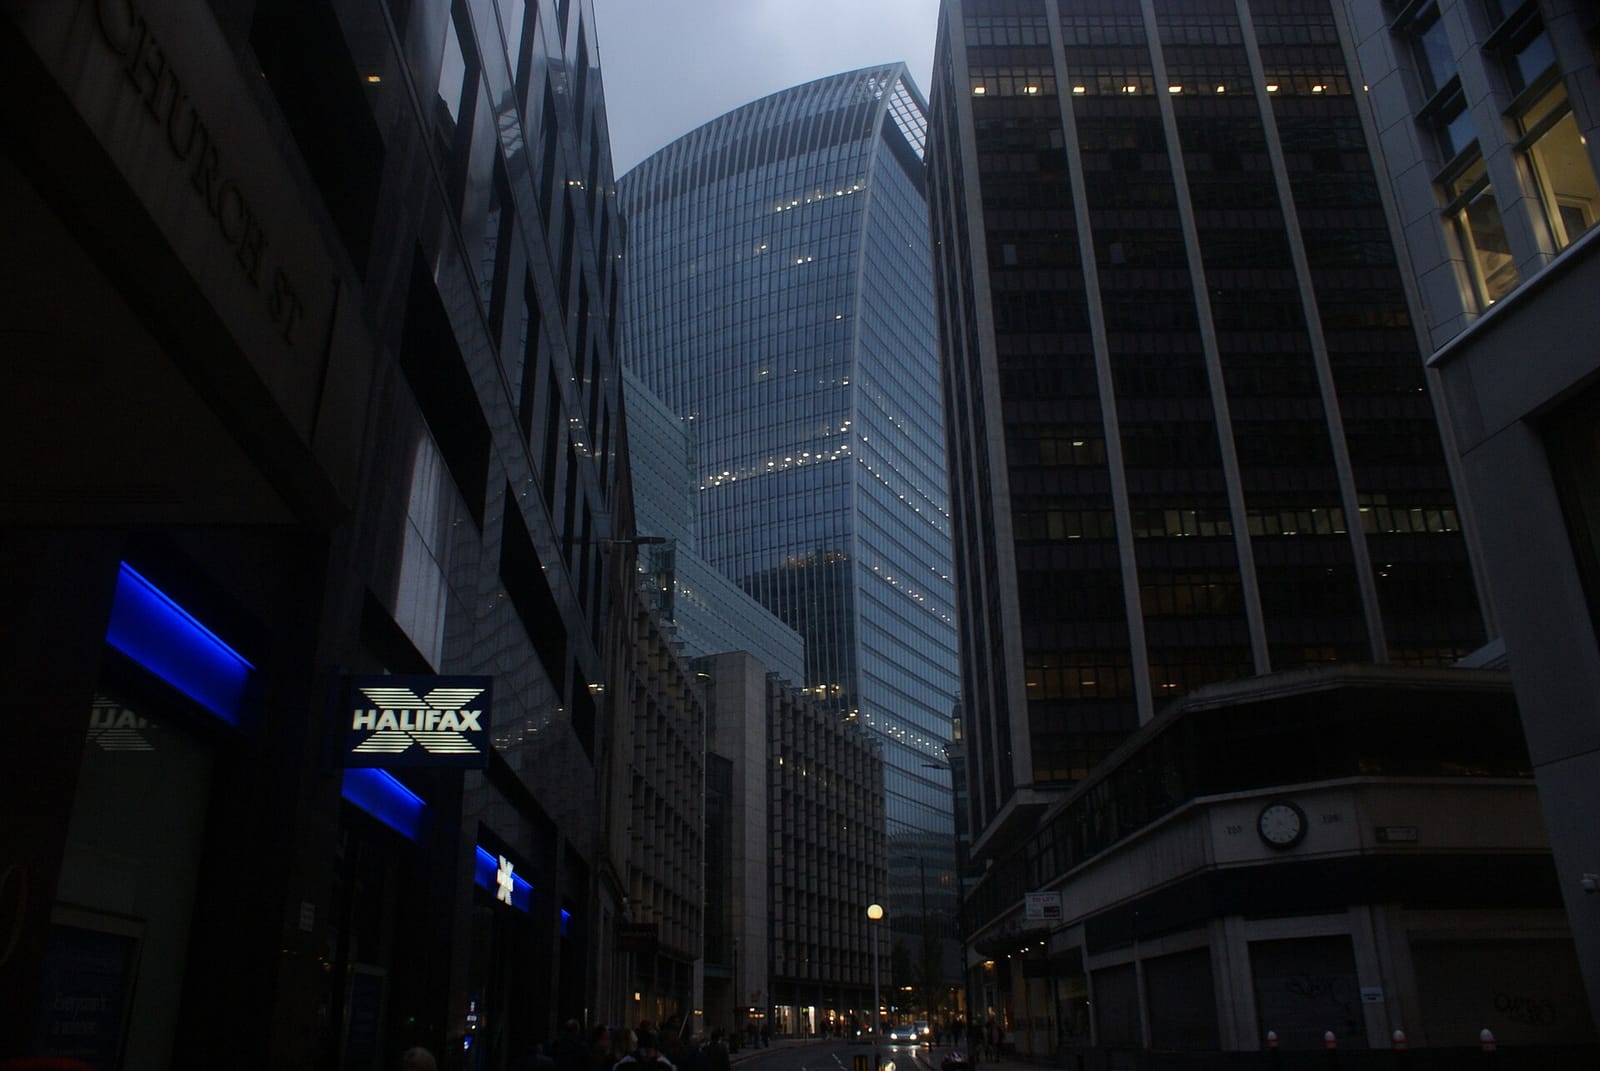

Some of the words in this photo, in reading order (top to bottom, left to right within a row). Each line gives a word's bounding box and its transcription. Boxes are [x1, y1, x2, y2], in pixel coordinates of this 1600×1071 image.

[94, 0, 269, 289] CHURCH
[269, 266, 304, 346] ST
[352, 708, 483, 732] HALIFAX
